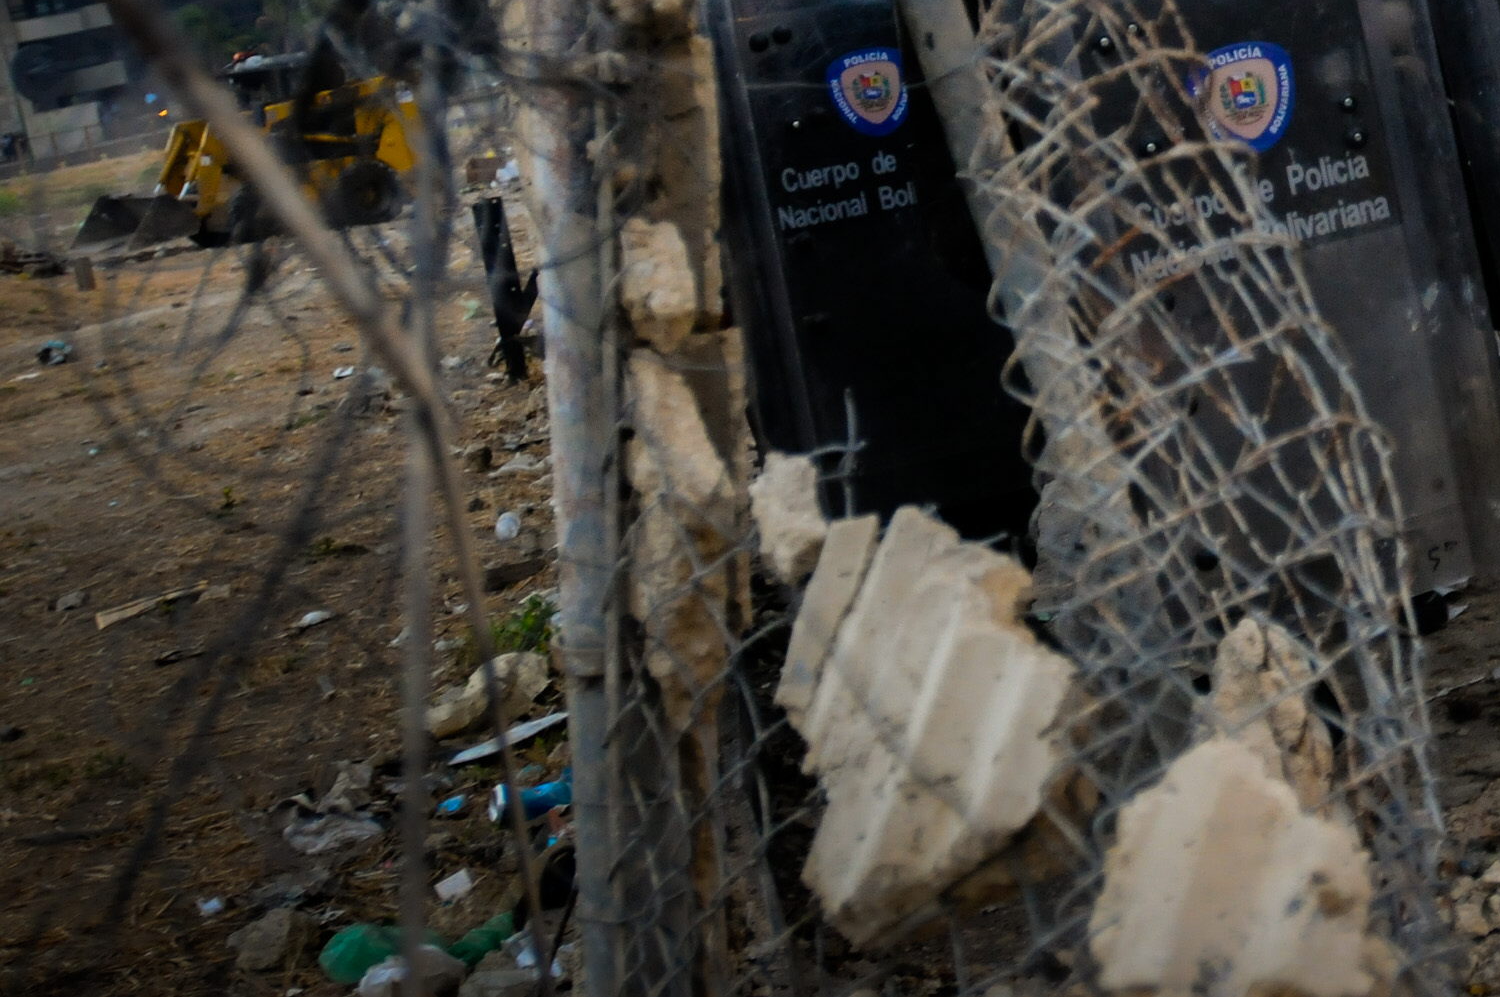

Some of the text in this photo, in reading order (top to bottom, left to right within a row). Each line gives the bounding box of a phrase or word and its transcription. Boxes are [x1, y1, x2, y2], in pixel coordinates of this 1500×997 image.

[844, 51, 888, 67] POLICÍA
[1208, 45, 1262, 69] POLICÍA
[830, 79, 858, 124] NACIONAL
[1268, 64, 1290, 135] BOLIVARIANA
[781, 151, 897, 193] Cuerpo de
[778, 191, 868, 230] Nacional
